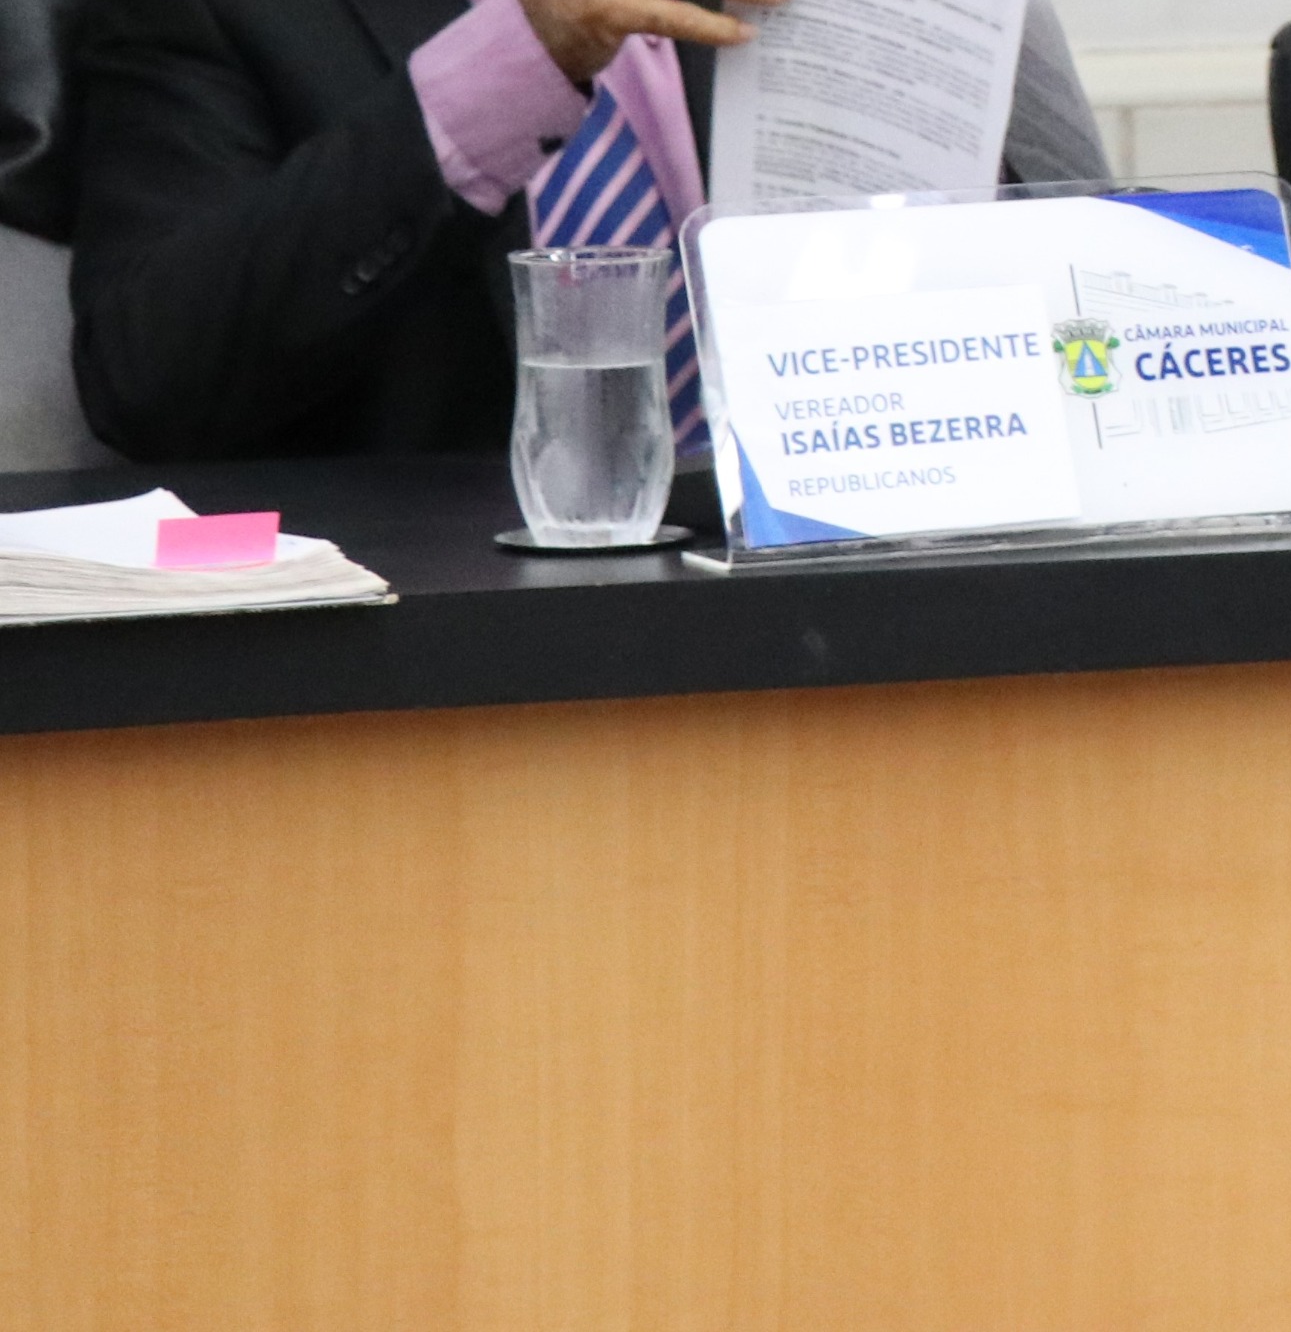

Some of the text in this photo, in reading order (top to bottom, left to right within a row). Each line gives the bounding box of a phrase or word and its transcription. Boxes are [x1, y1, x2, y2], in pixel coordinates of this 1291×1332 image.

[1124, 318, 1290, 343] CÂMARA MUNICIPAL
[767, 332, 1041, 377] VICE-PRESIDENTE
[1134, 342, 1291, 381] CÁCERES
[774, 392, 905, 420] VEREADOR
[781, 412, 1028, 455] ISAÍAS BEZERRA
[788, 466, 956, 497] REPUBLICANOS
